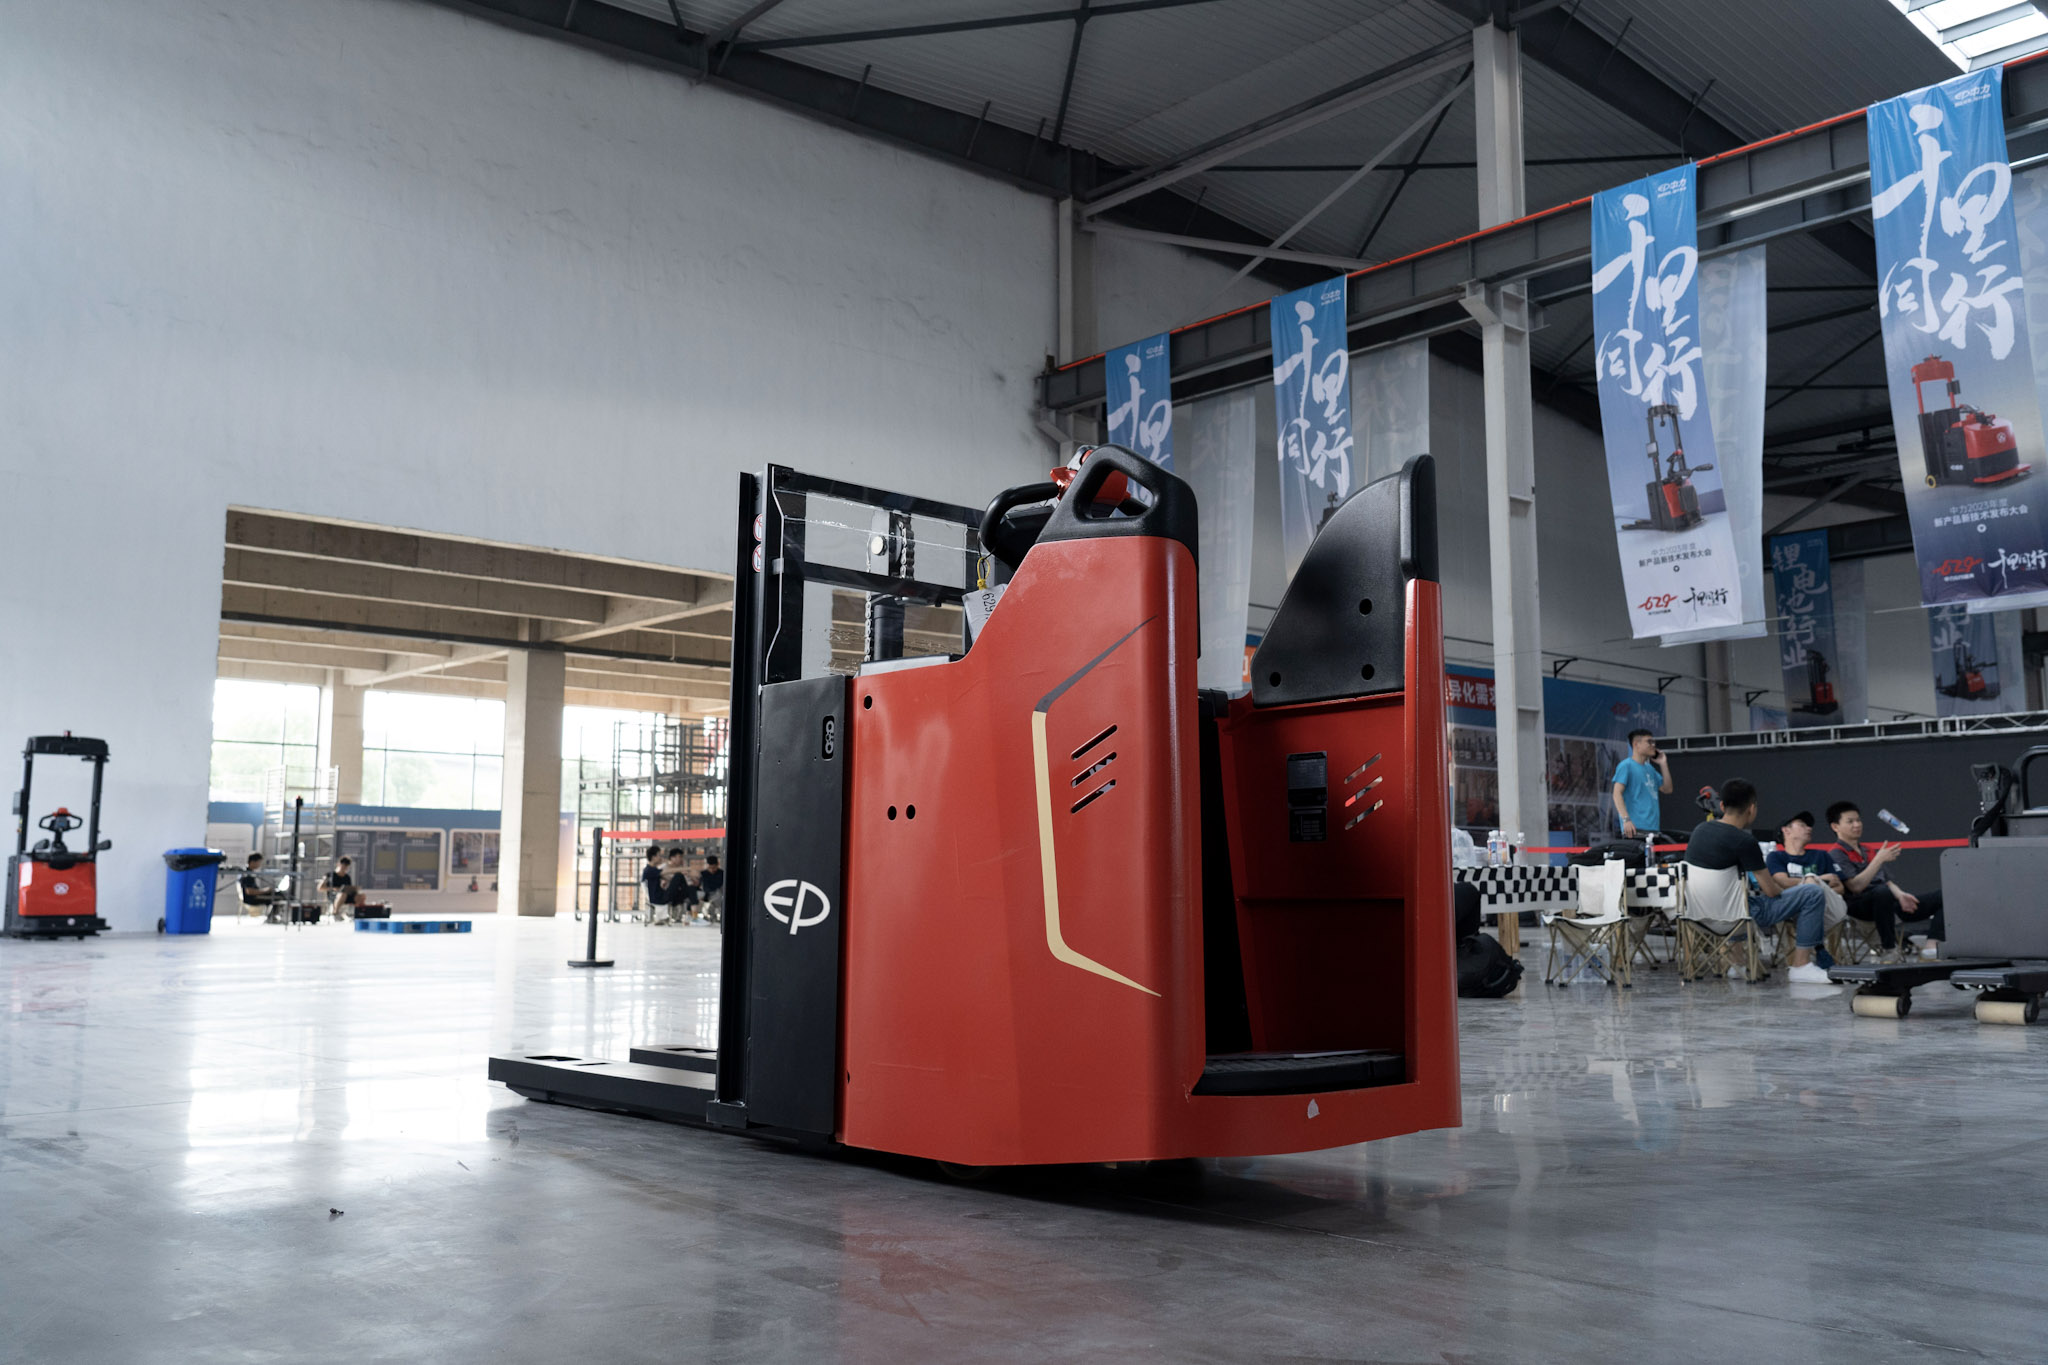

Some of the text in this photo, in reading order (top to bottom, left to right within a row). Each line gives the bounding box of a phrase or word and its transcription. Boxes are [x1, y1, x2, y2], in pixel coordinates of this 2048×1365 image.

[1934, 504, 2029, 527] 新产品新技术发布大会
[1639, 548, 1712, 568] 新产品新技术发布大会
[982, 592, 997, 620] 629
[763, 879, 831, 936] EP
